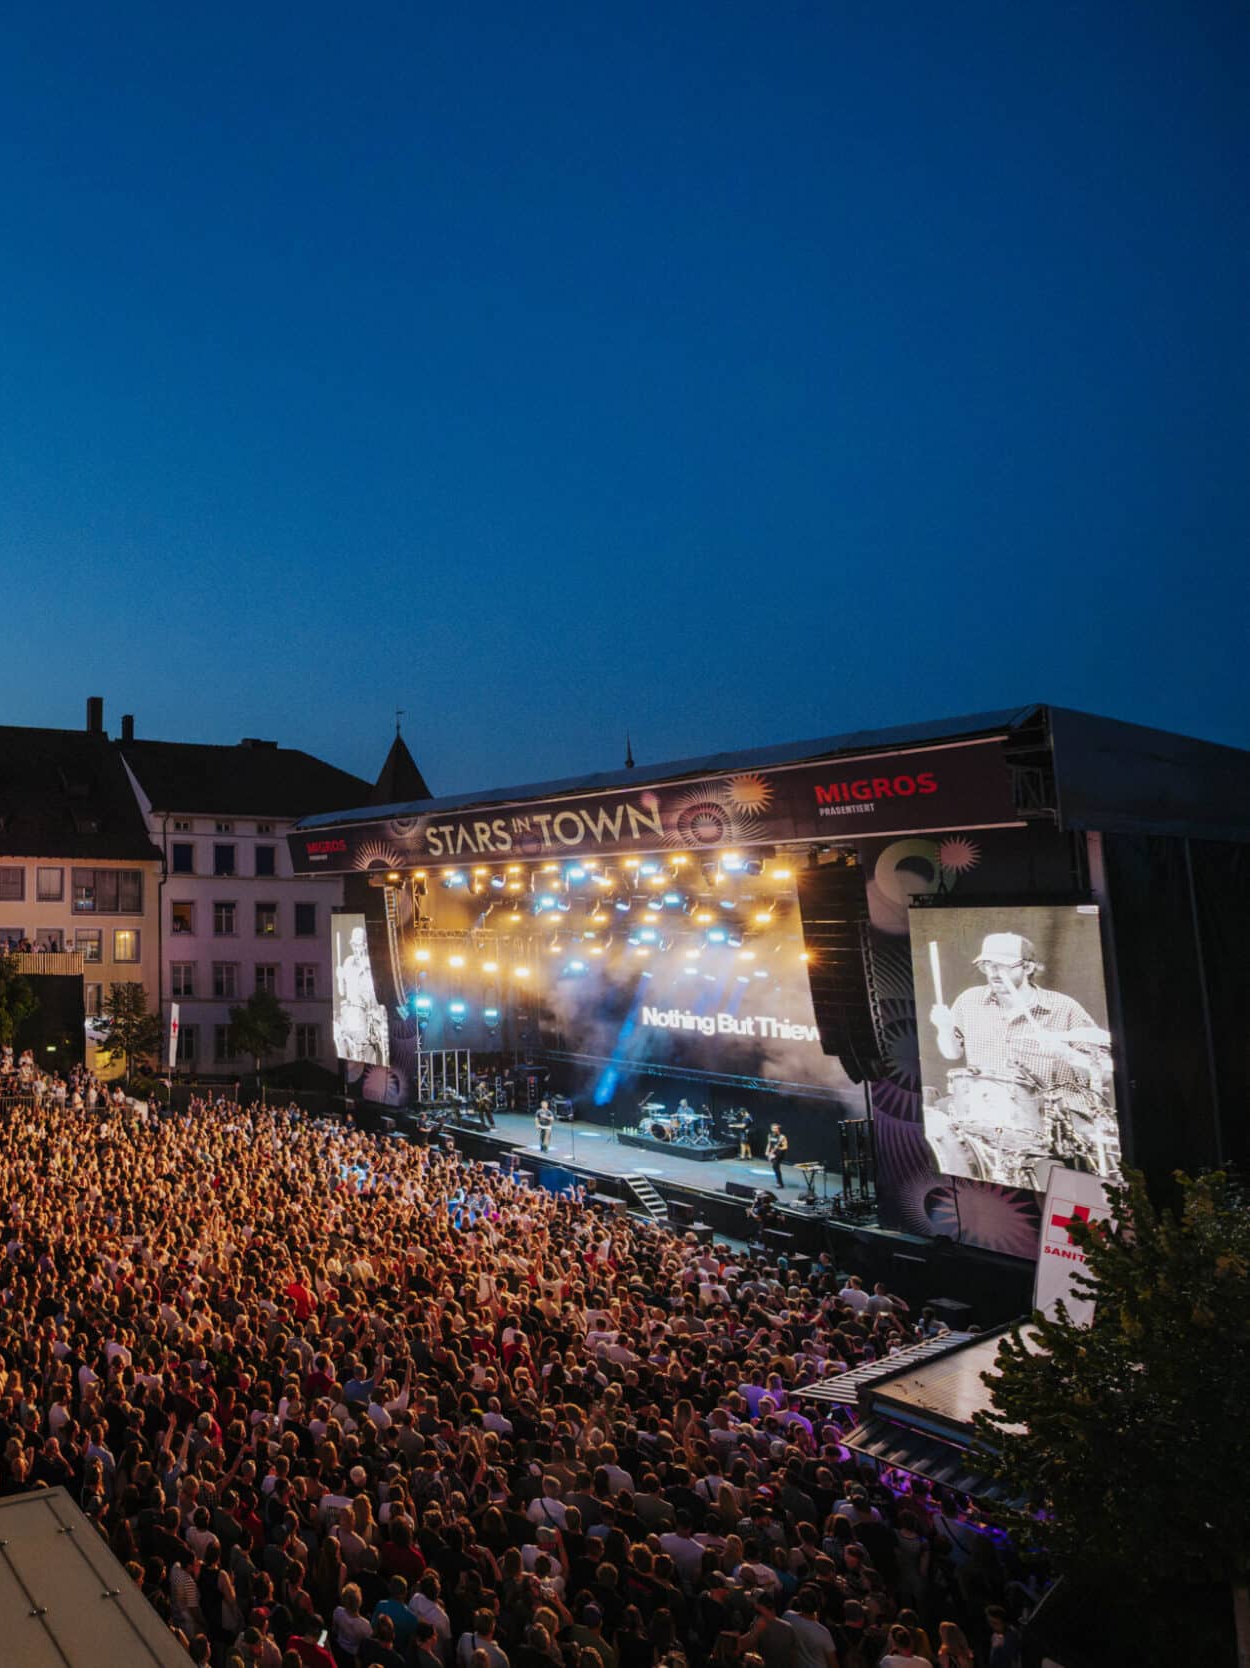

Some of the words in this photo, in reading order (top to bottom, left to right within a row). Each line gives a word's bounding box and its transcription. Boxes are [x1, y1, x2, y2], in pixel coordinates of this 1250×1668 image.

[814, 772, 938, 805] MIGROS
[425, 819, 512, 856] STARS
[512, 817, 532, 833] IN
[533, 802, 665, 848] TOWN
[642, 1007, 715, 1036] Nothing
[717, 1013, 755, 1036] But
